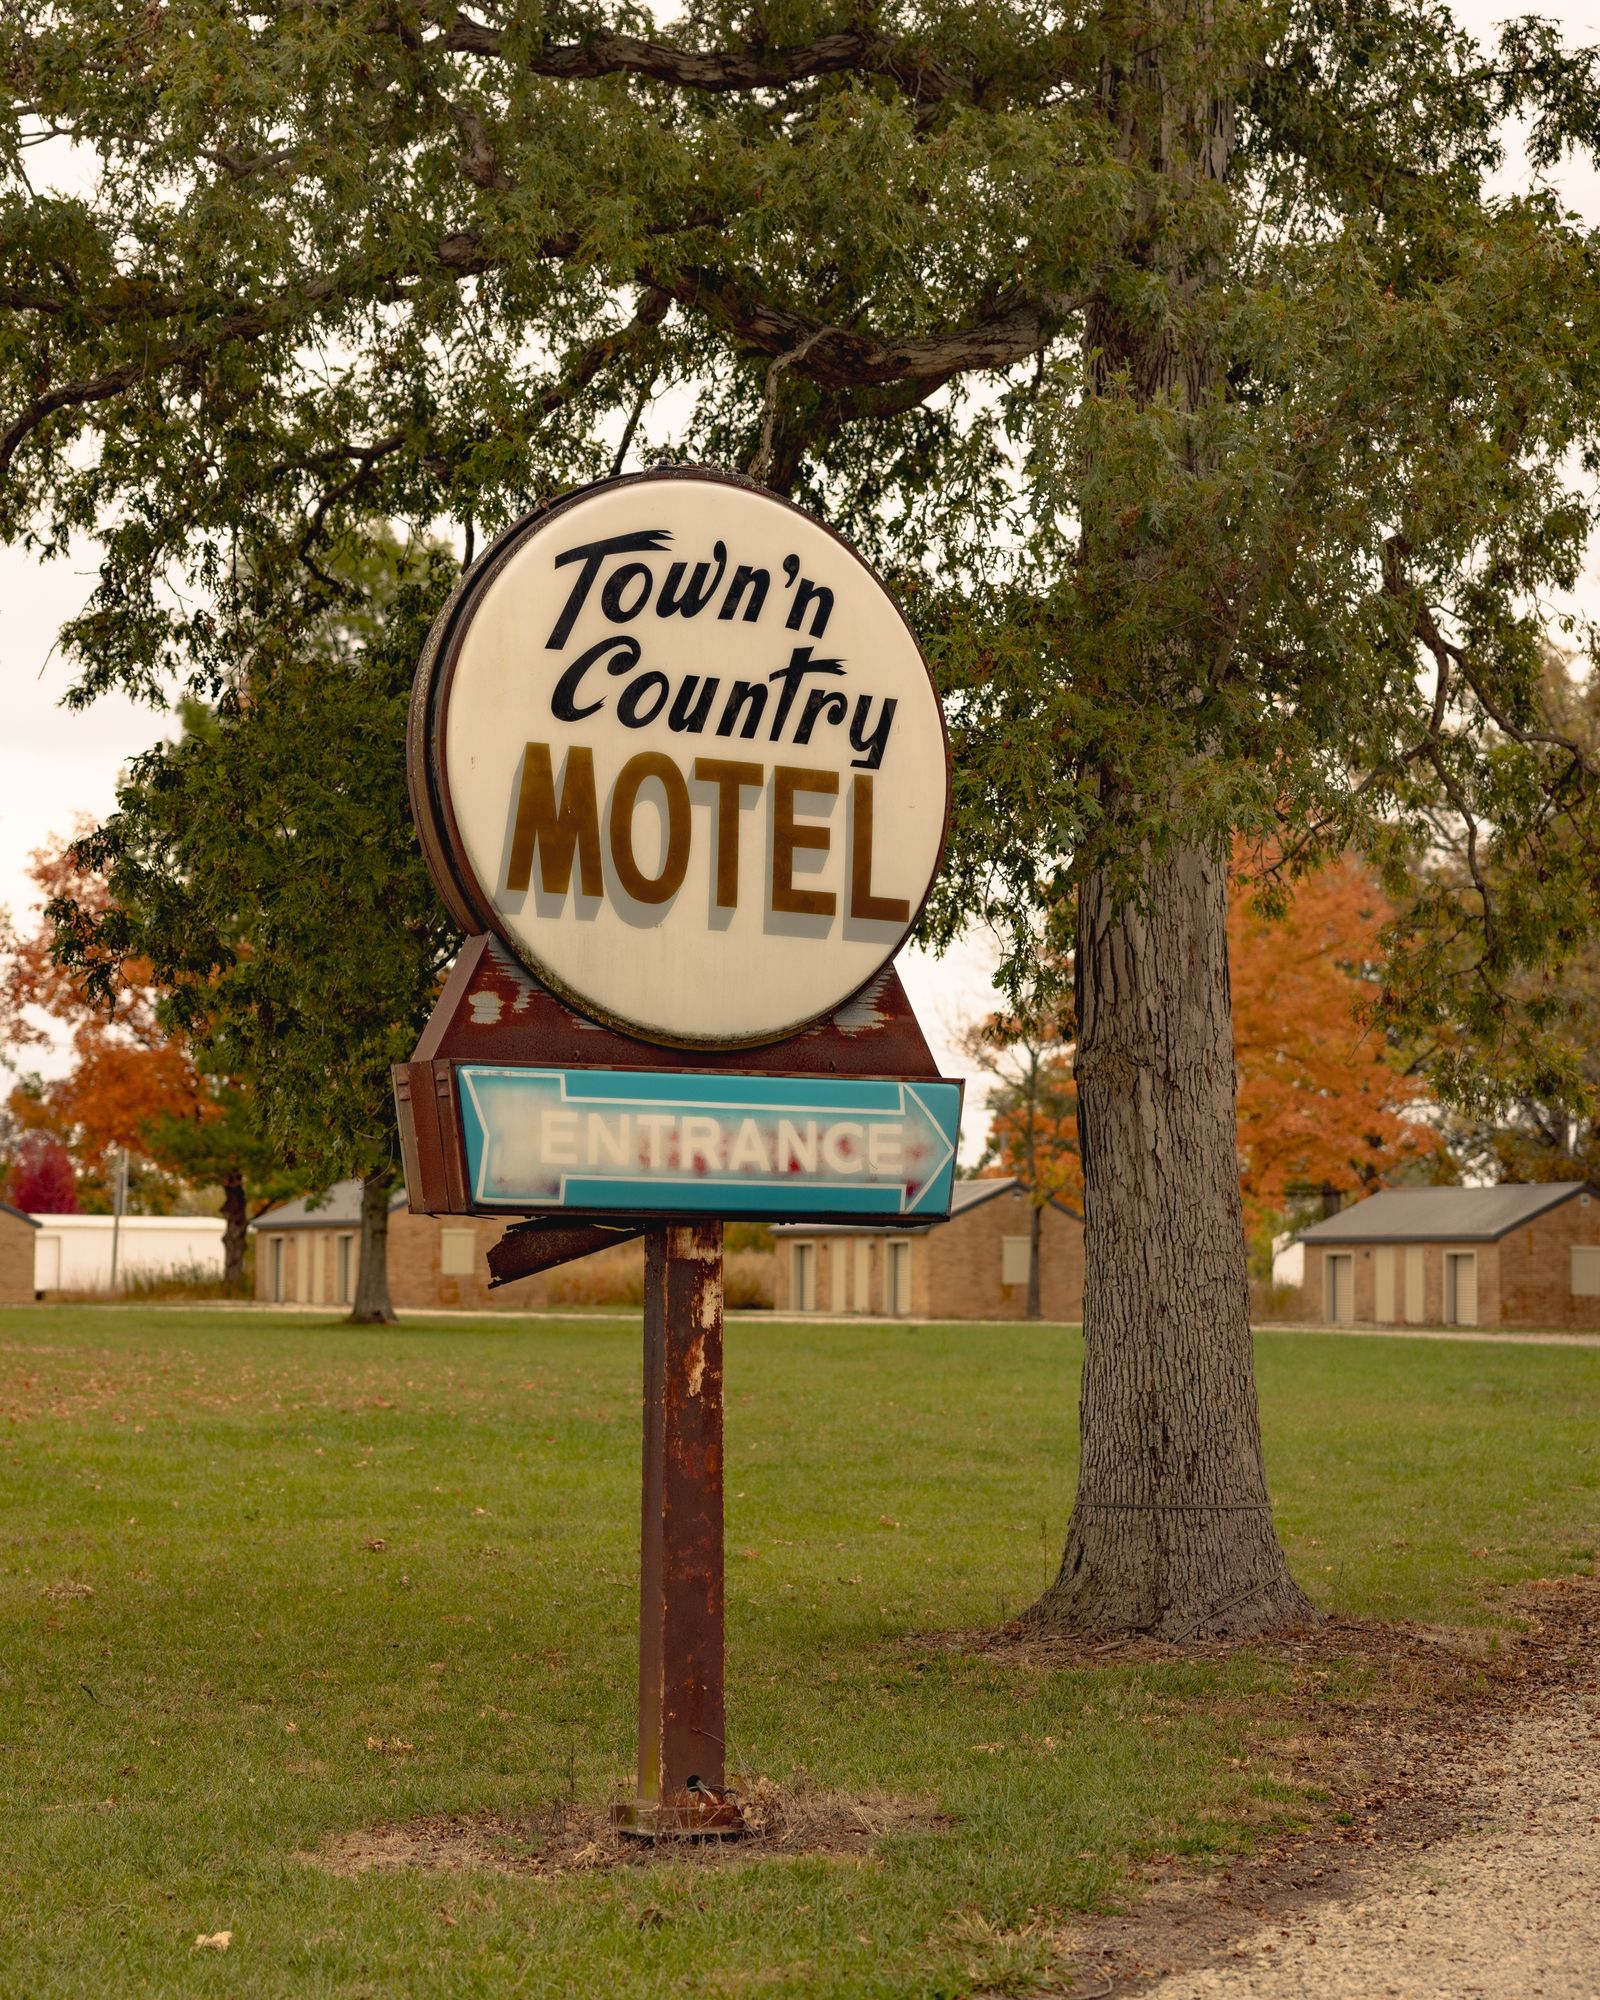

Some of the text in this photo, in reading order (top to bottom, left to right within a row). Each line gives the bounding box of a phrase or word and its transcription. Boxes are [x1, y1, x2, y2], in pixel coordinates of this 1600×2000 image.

[551, 636, 898, 769] Country
[507, 742, 909, 922] MOTEL
[539, 1110, 904, 1175] ENTRANCE
